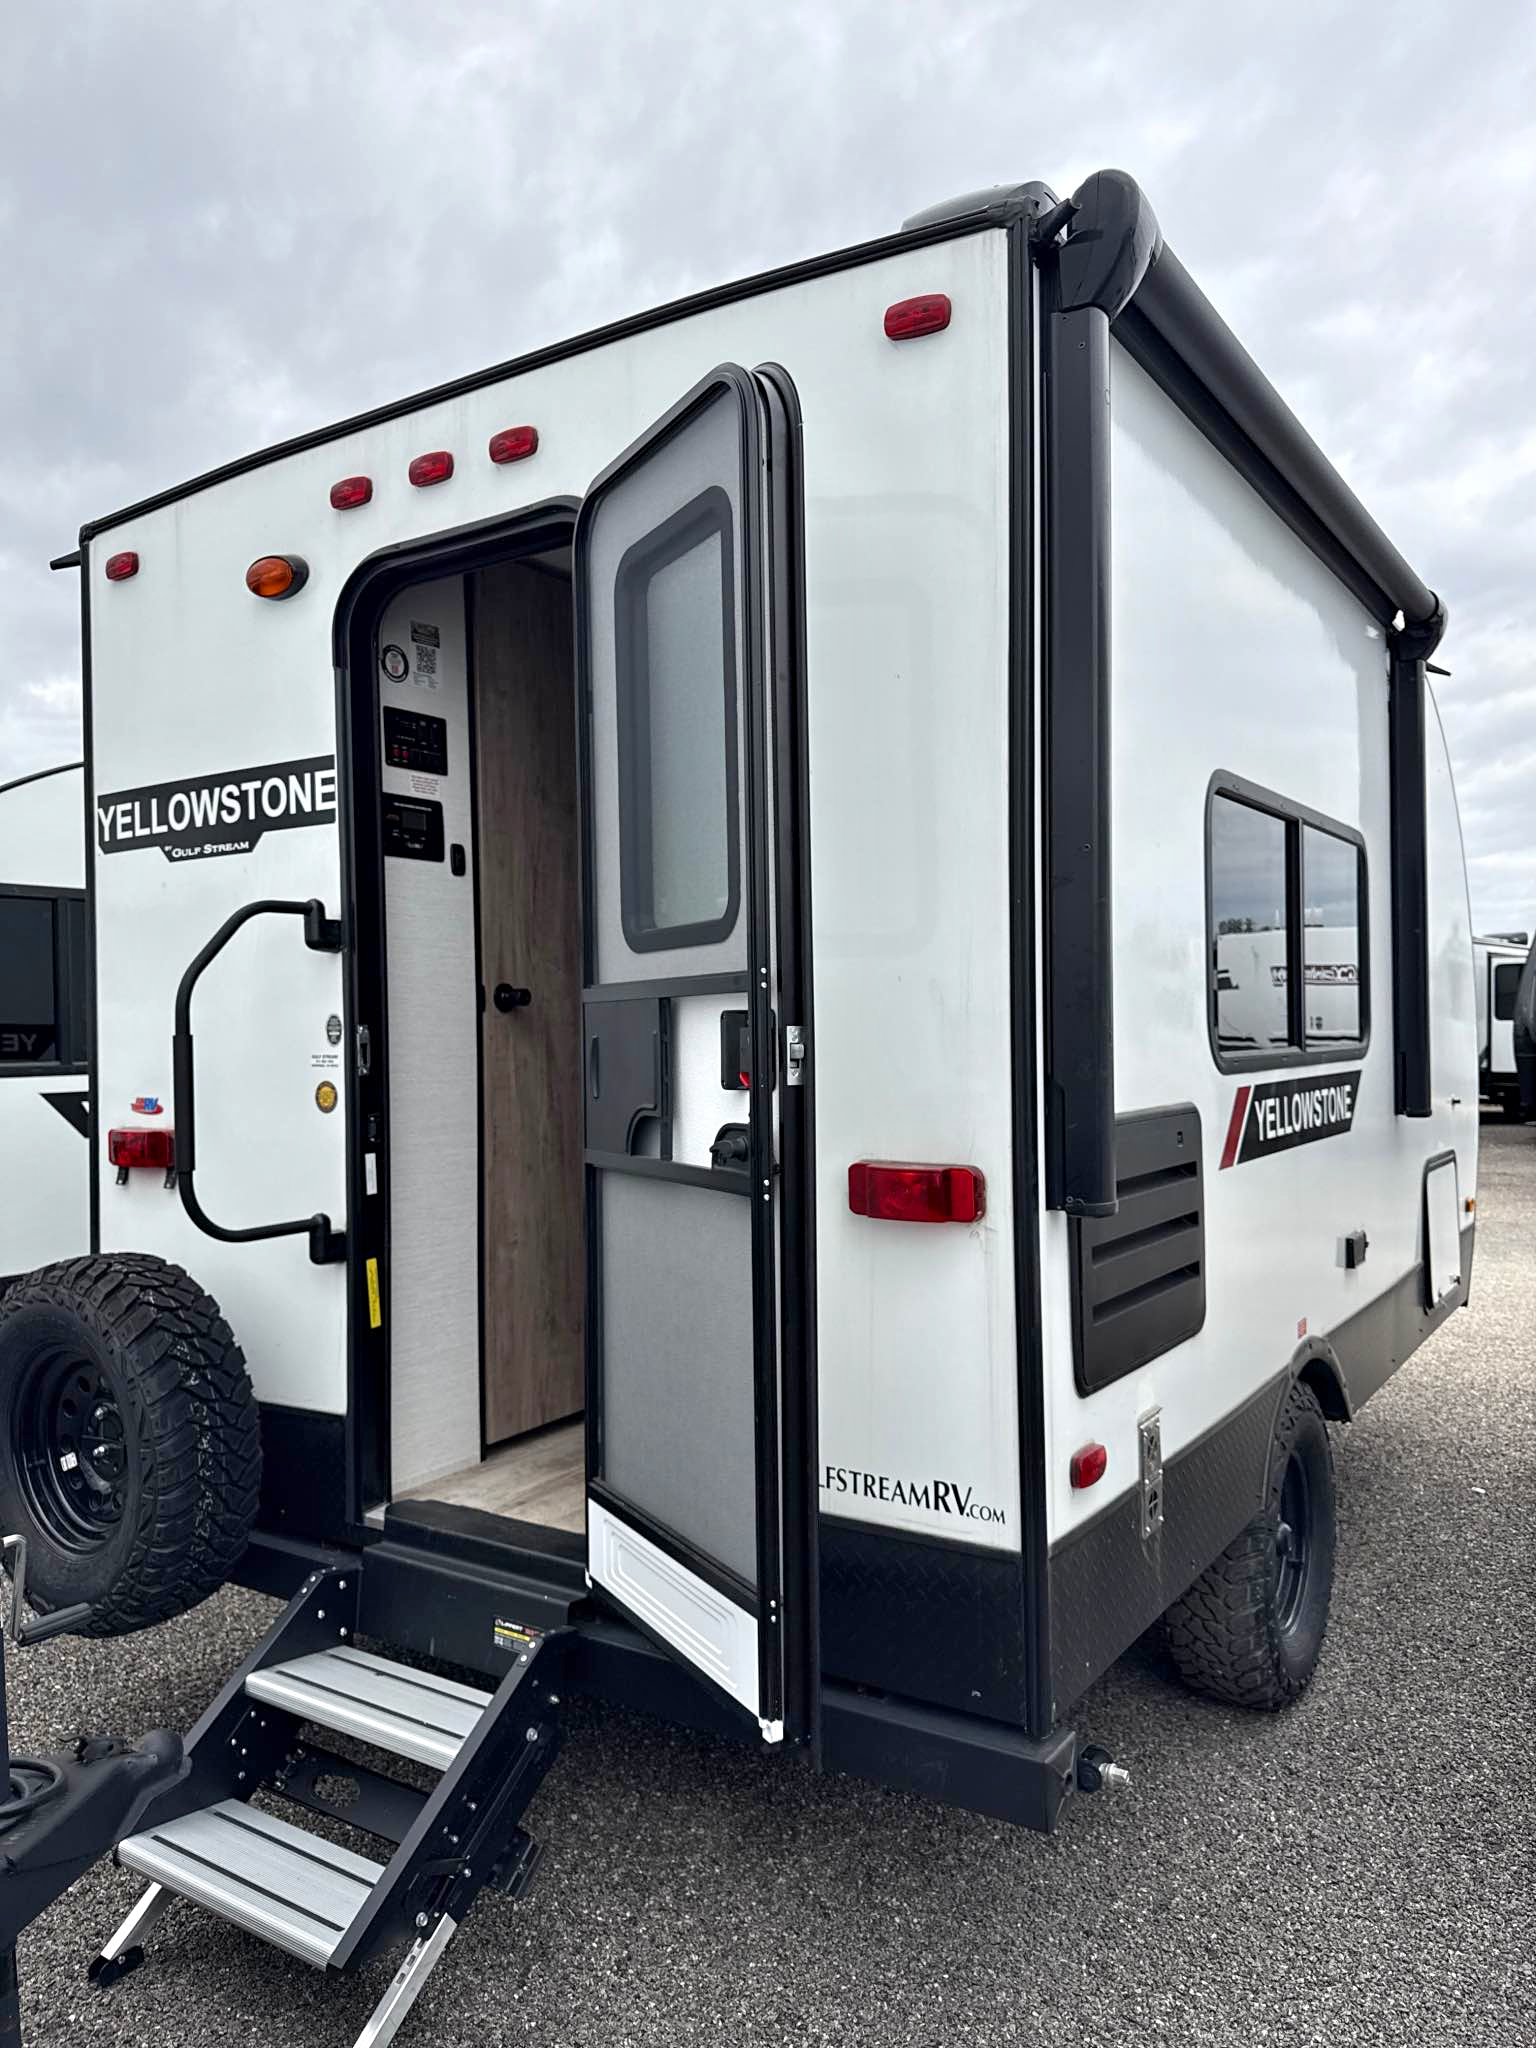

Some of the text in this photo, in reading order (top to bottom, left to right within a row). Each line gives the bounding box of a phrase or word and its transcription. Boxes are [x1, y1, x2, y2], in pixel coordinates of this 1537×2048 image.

[97, 768, 336, 842] YELLOWSTONE
[172, 847, 201, 858] GULF
[203, 841, 249, 854] STREAM
[1254, 1085, 1352, 1142] YELLOWSTONE
